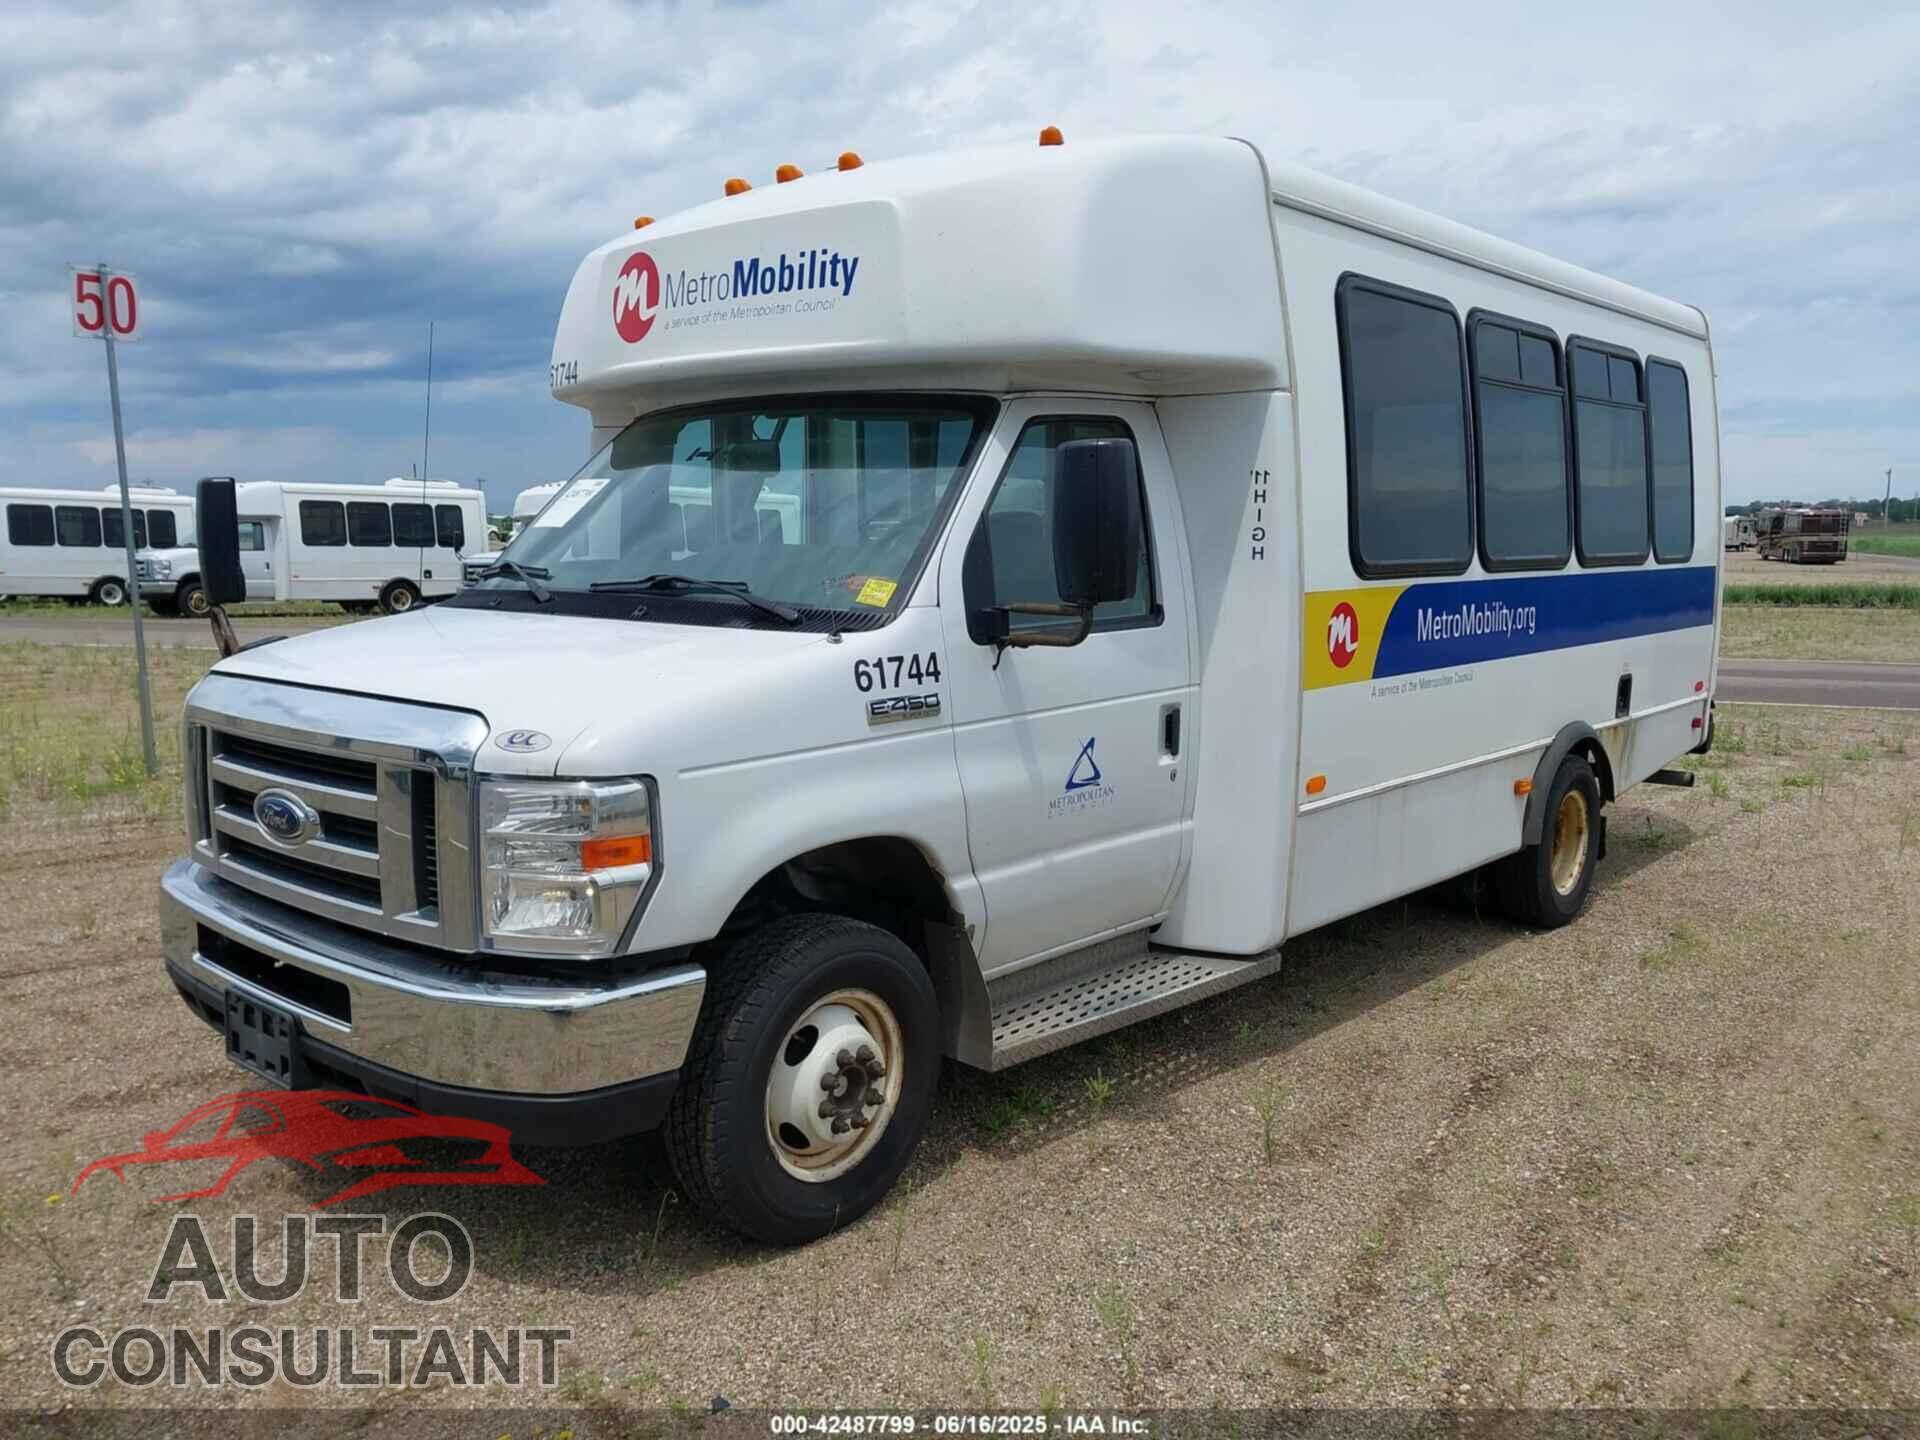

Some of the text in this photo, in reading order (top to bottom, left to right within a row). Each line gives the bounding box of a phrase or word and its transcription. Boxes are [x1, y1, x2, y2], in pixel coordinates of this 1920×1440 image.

[664, 249, 859, 309] MetroMobility
[76, 272, 137, 334] 50
[671, 314, 700, 328] service
[701, 311, 714, 324] of
[713, 309, 730, 323] the
[730, 302, 793, 321] Metropolitan
[795, 297, 836, 313] Council
[1416, 603, 1537, 642] MetroMobility.org
[854, 651, 941, 692] 61744
